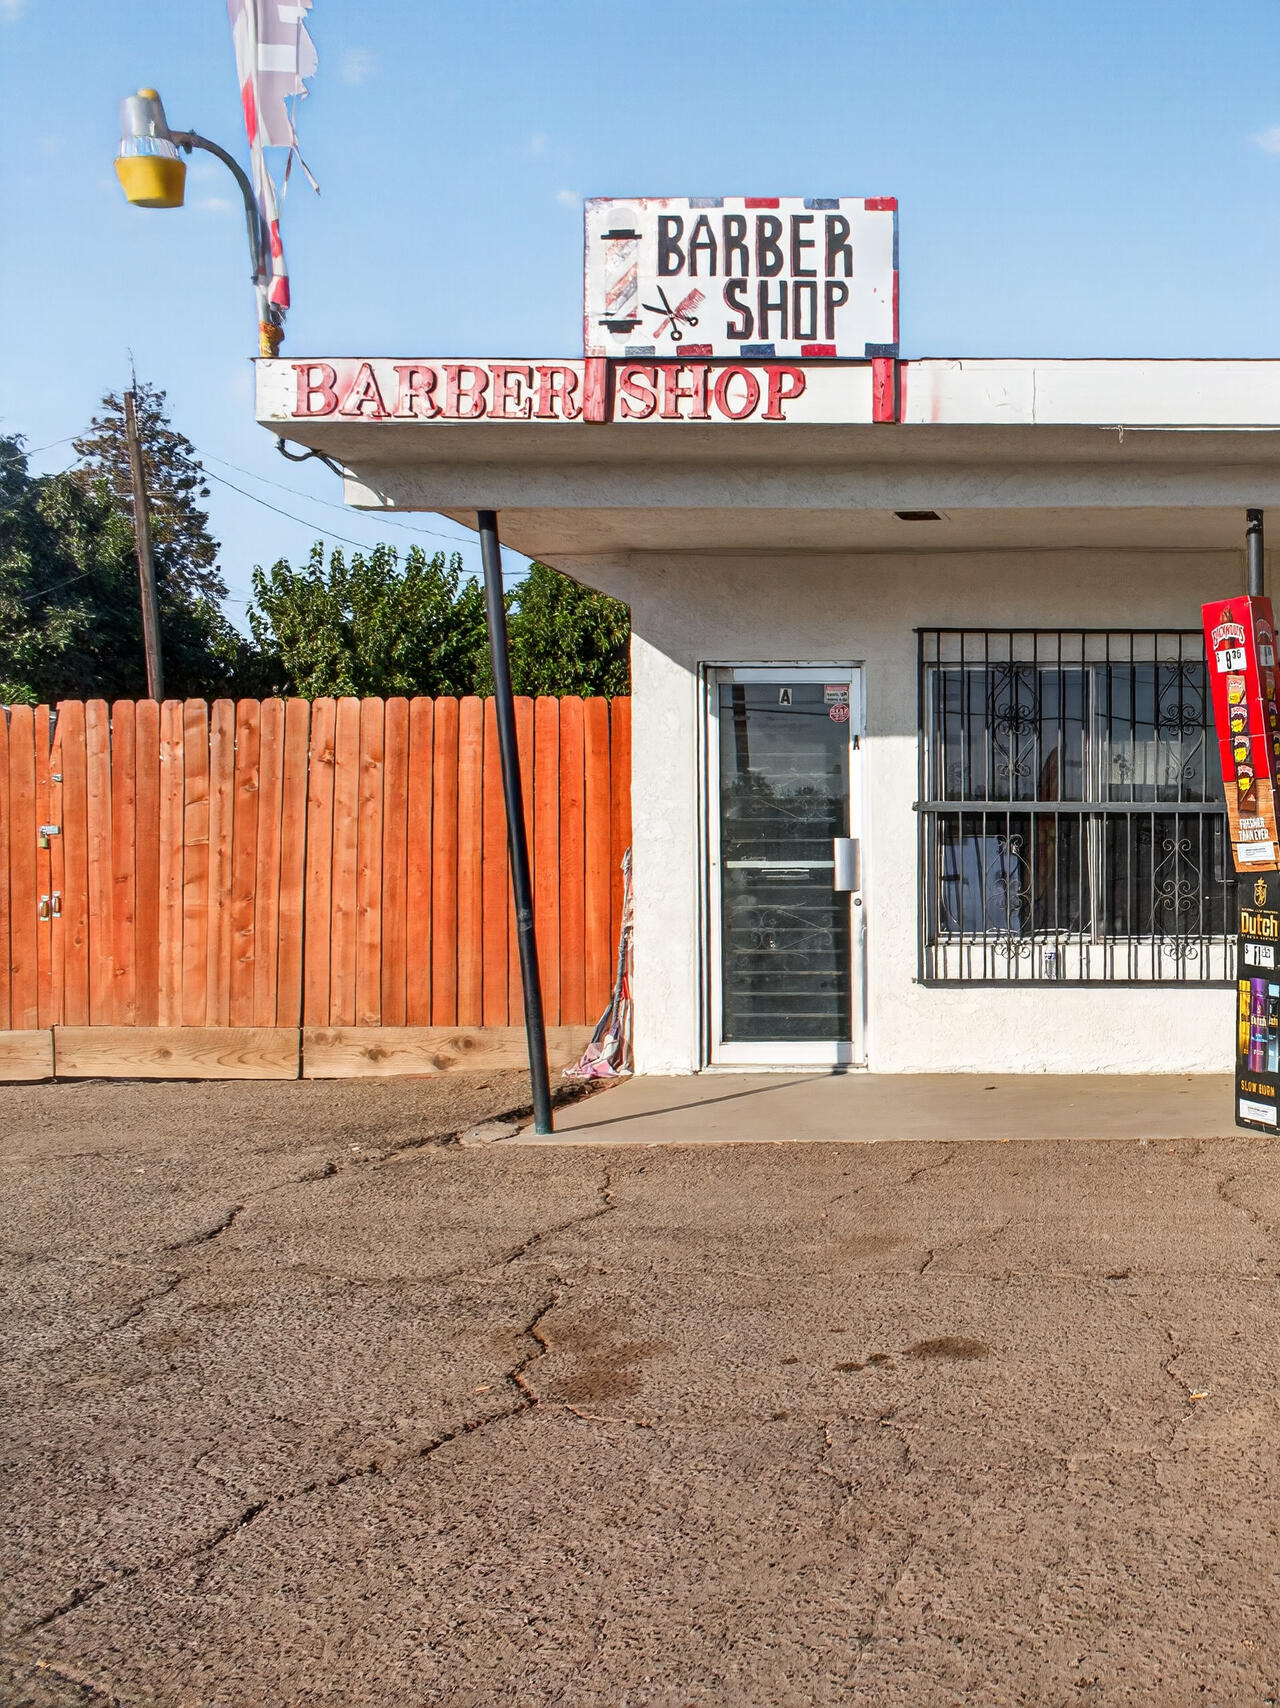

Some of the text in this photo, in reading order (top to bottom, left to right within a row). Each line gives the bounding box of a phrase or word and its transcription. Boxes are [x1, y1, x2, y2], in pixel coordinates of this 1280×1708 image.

[657, 214, 853, 277] BARBER
[726, 278, 850, 340] SHOP
[291, 363, 807, 420] BARBER SHOP
[780, 689, 791, 705] A
[853, 735, 860, 750] A
[1241, 911, 1279, 937] Dutch
[1240, 1080, 1257, 1094] SLOW
